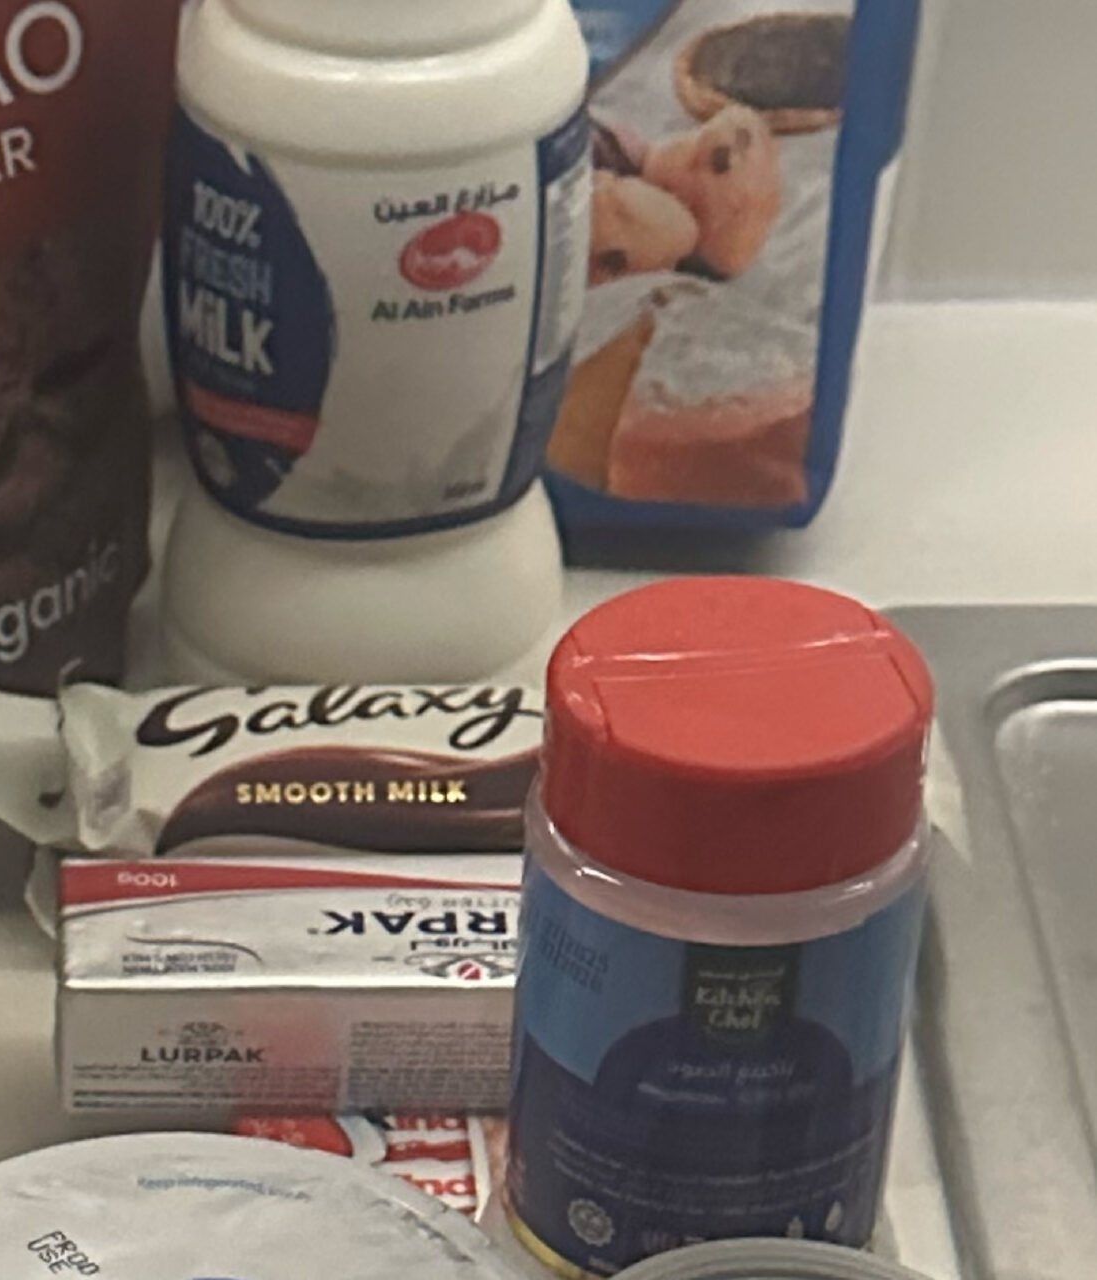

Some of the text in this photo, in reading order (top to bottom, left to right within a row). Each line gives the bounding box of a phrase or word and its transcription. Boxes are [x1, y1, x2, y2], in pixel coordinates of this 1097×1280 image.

[192, 180, 263, 249] 100%
[372, 192, 450, 224] العين
[179, 224, 273, 305] FRESH
[371, 283, 515, 322] Al Ain Farms
[137, 684, 545, 757] Galaxy
[236, 780, 467, 805] SMOOTH MILK
[117, 871, 179, 888] 100g
[442, 895, 518, 909] UTTER
[324, 910, 507, 935] RPAK
[693, 985, 781, 1007] Kitchen
[707, 1007, 762, 1031] Chef
[140, 1046, 265, 1063] LURPAK
[26, 1233, 73, 1275] USE
